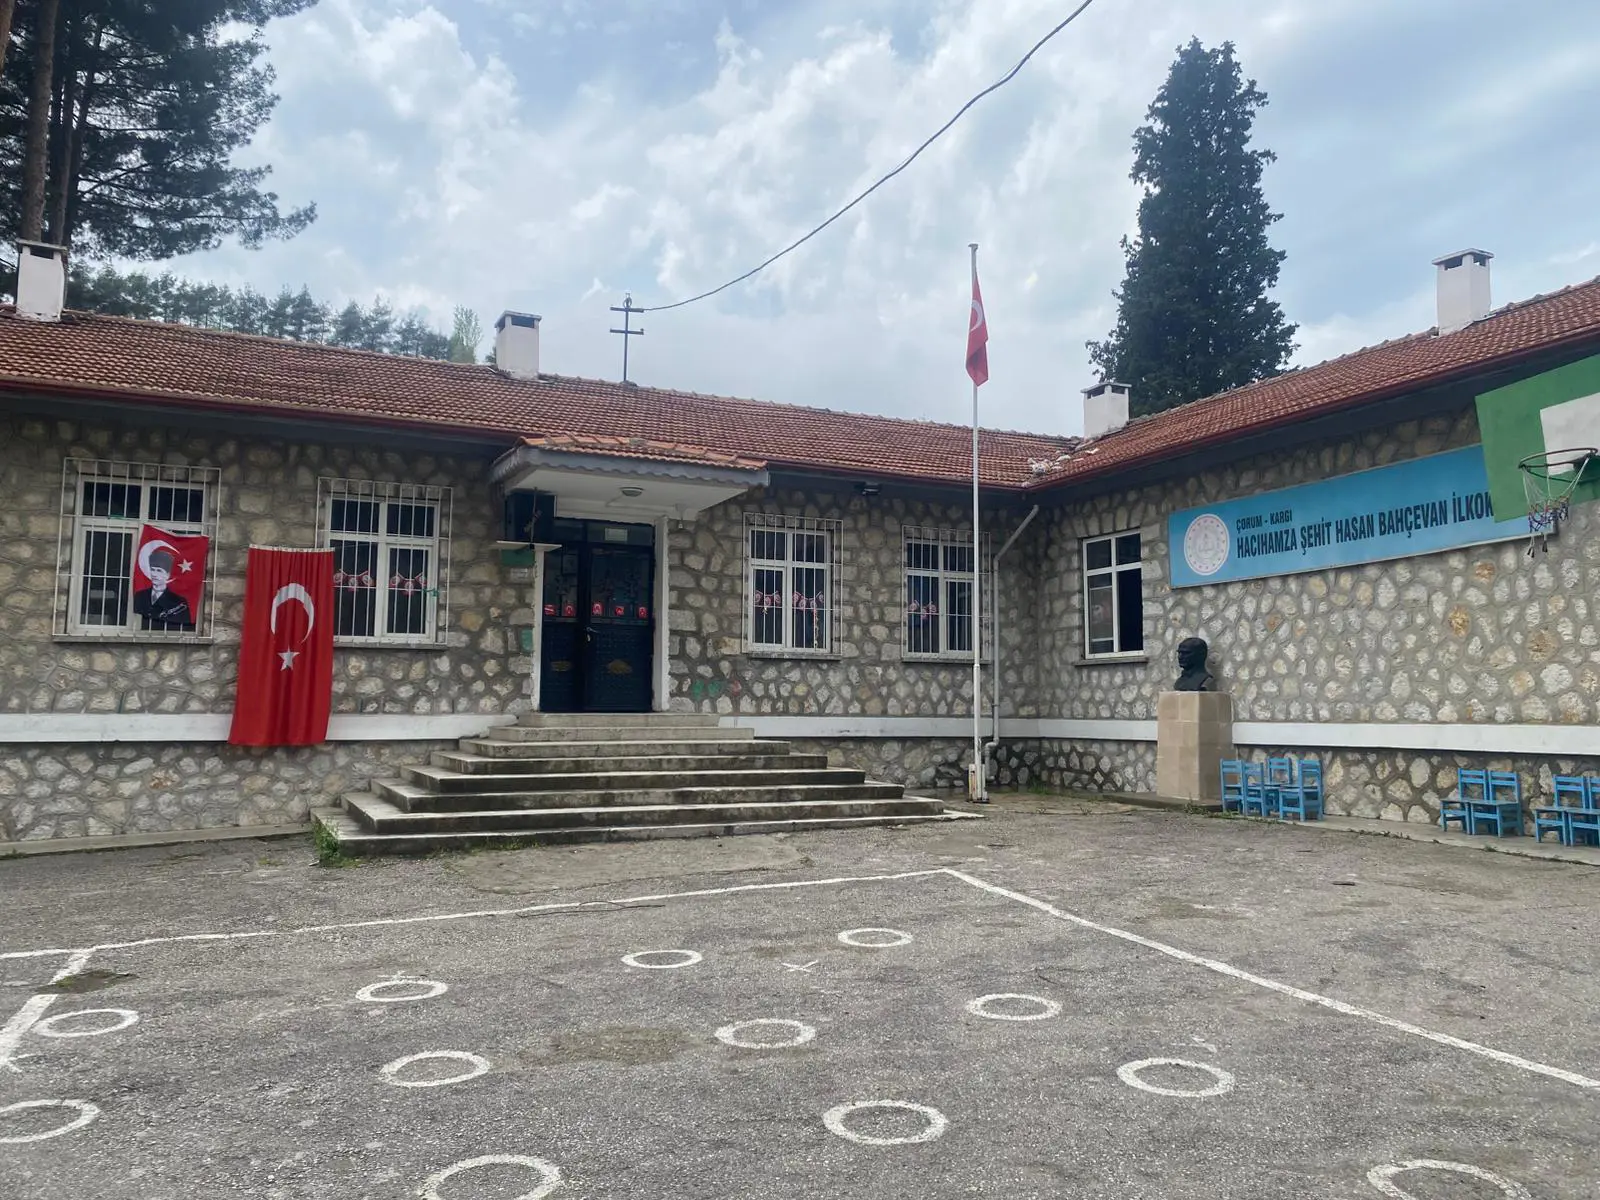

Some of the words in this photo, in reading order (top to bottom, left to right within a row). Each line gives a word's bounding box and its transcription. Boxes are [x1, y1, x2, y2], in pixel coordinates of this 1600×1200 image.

[1236, 515, 1263, 534] ÇORUM
[1270, 509, 1293, 525] KARGI
[1237, 528, 1298, 559] HACIHAMZA
[1300, 516, 1332, 556] ŞEHİT
[1335, 513, 1375, 544] HASAN
[1378, 499, 1448, 538] BAHÇEVAN
